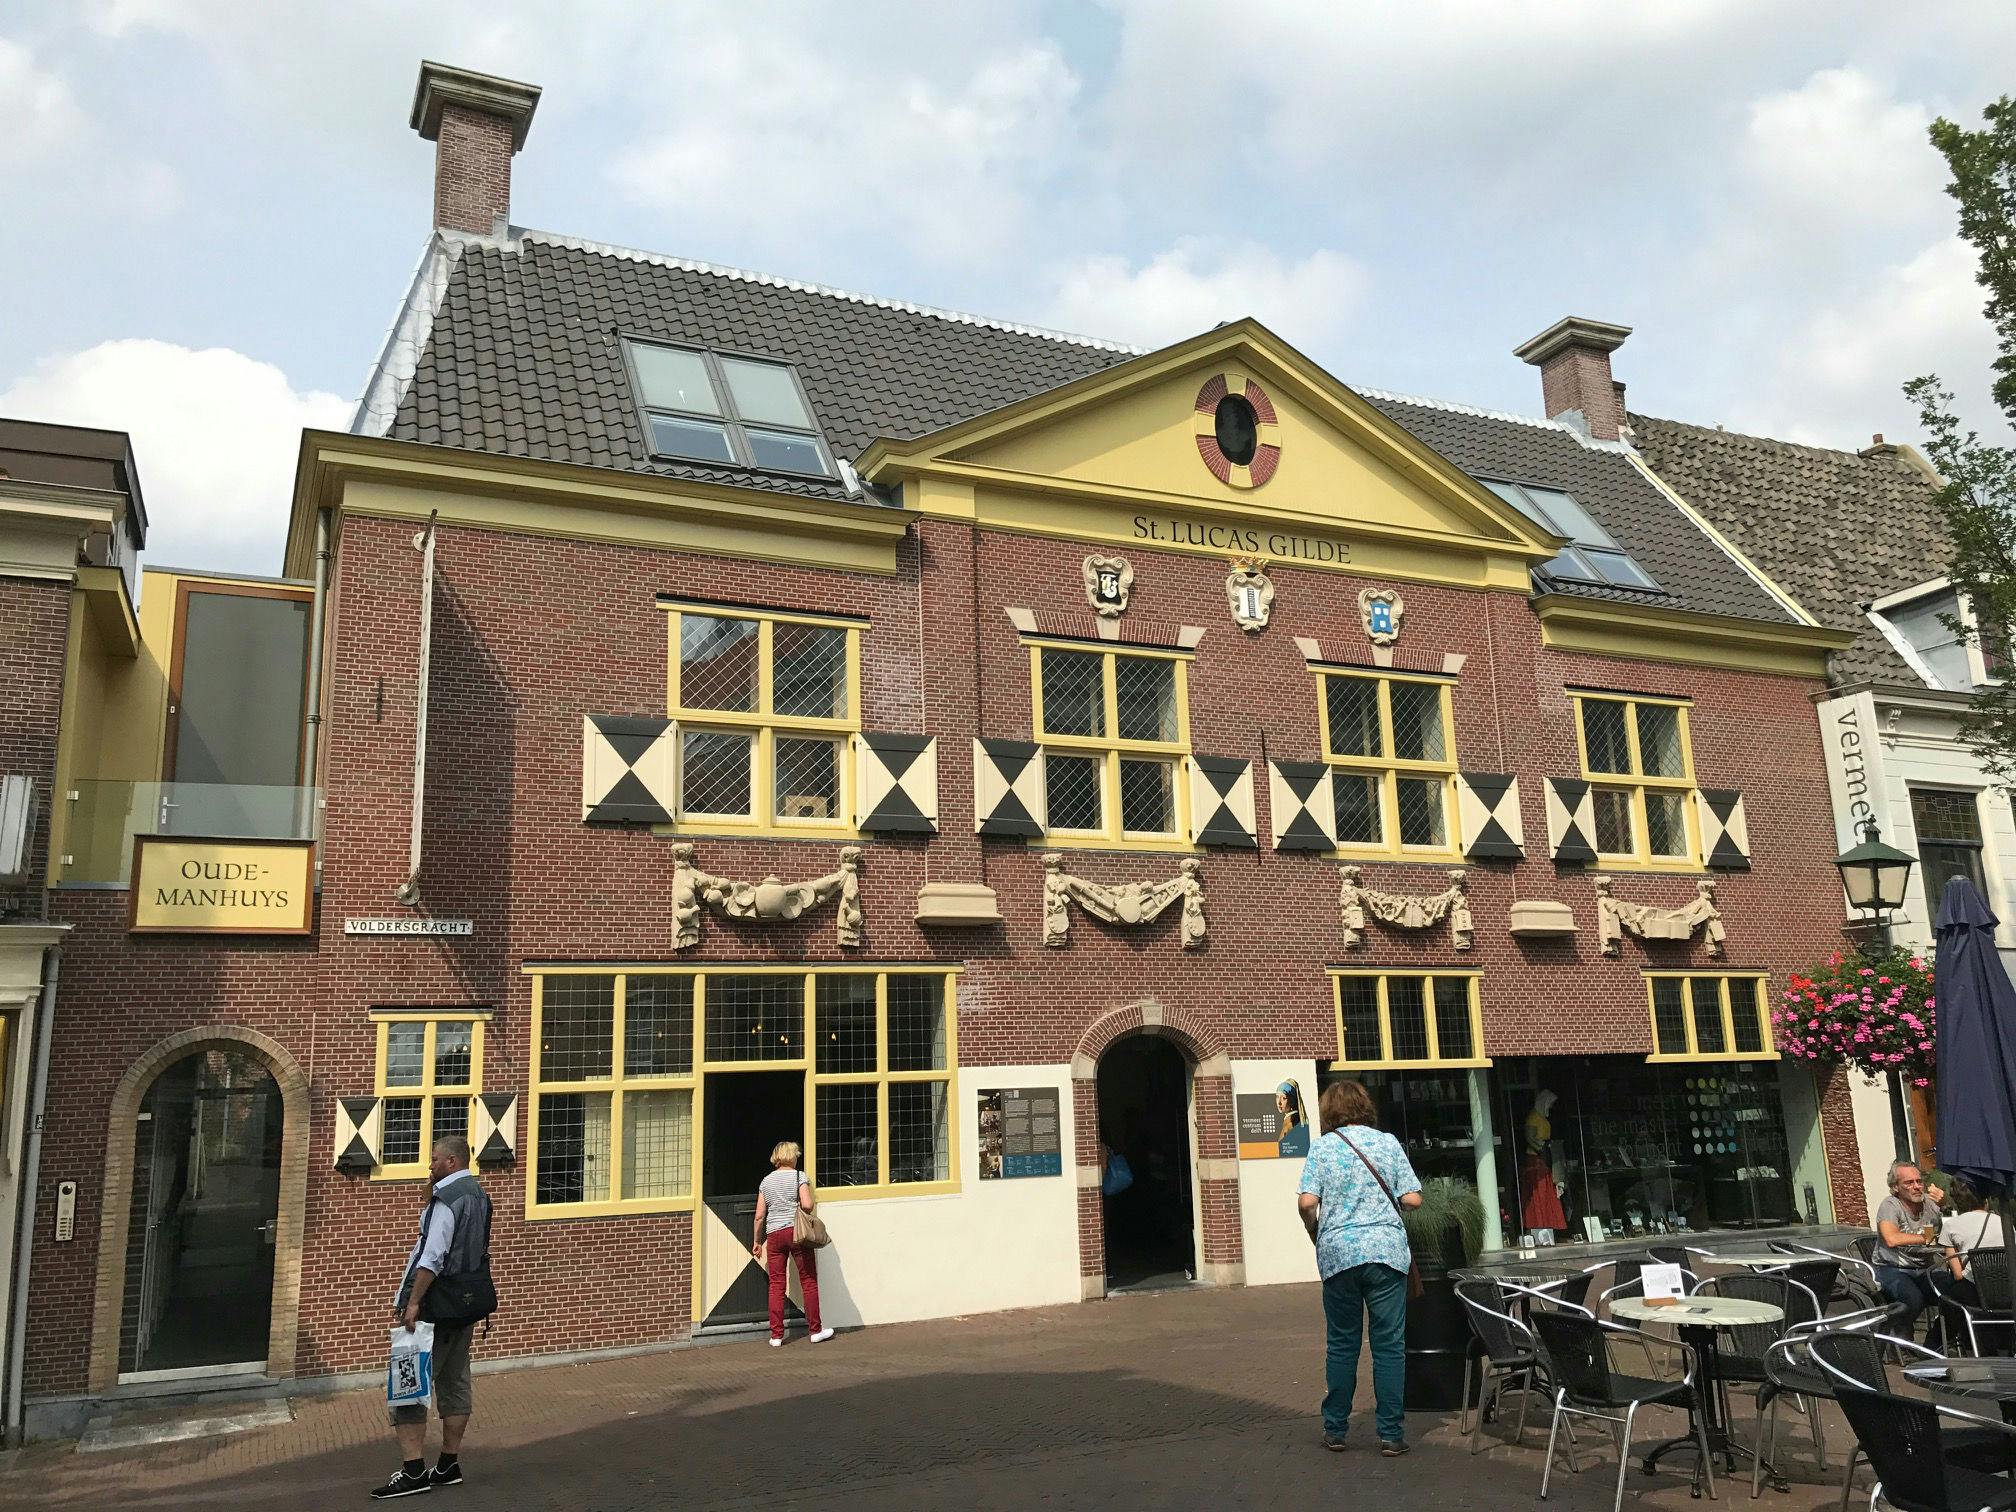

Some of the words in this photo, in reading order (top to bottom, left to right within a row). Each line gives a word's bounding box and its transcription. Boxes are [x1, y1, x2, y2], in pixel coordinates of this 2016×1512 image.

[1133, 516, 1165, 540] St.
[1171, 521, 1259, 552] LUCAS
[1268, 534, 1352, 564] GILDE
[1838, 708, 1870, 845] vermee
[181, 860, 269, 881] OUDE-
[155, 888, 288, 908] MANHUYS
[351, 921, 468, 933] VOLDERSGRACHT
